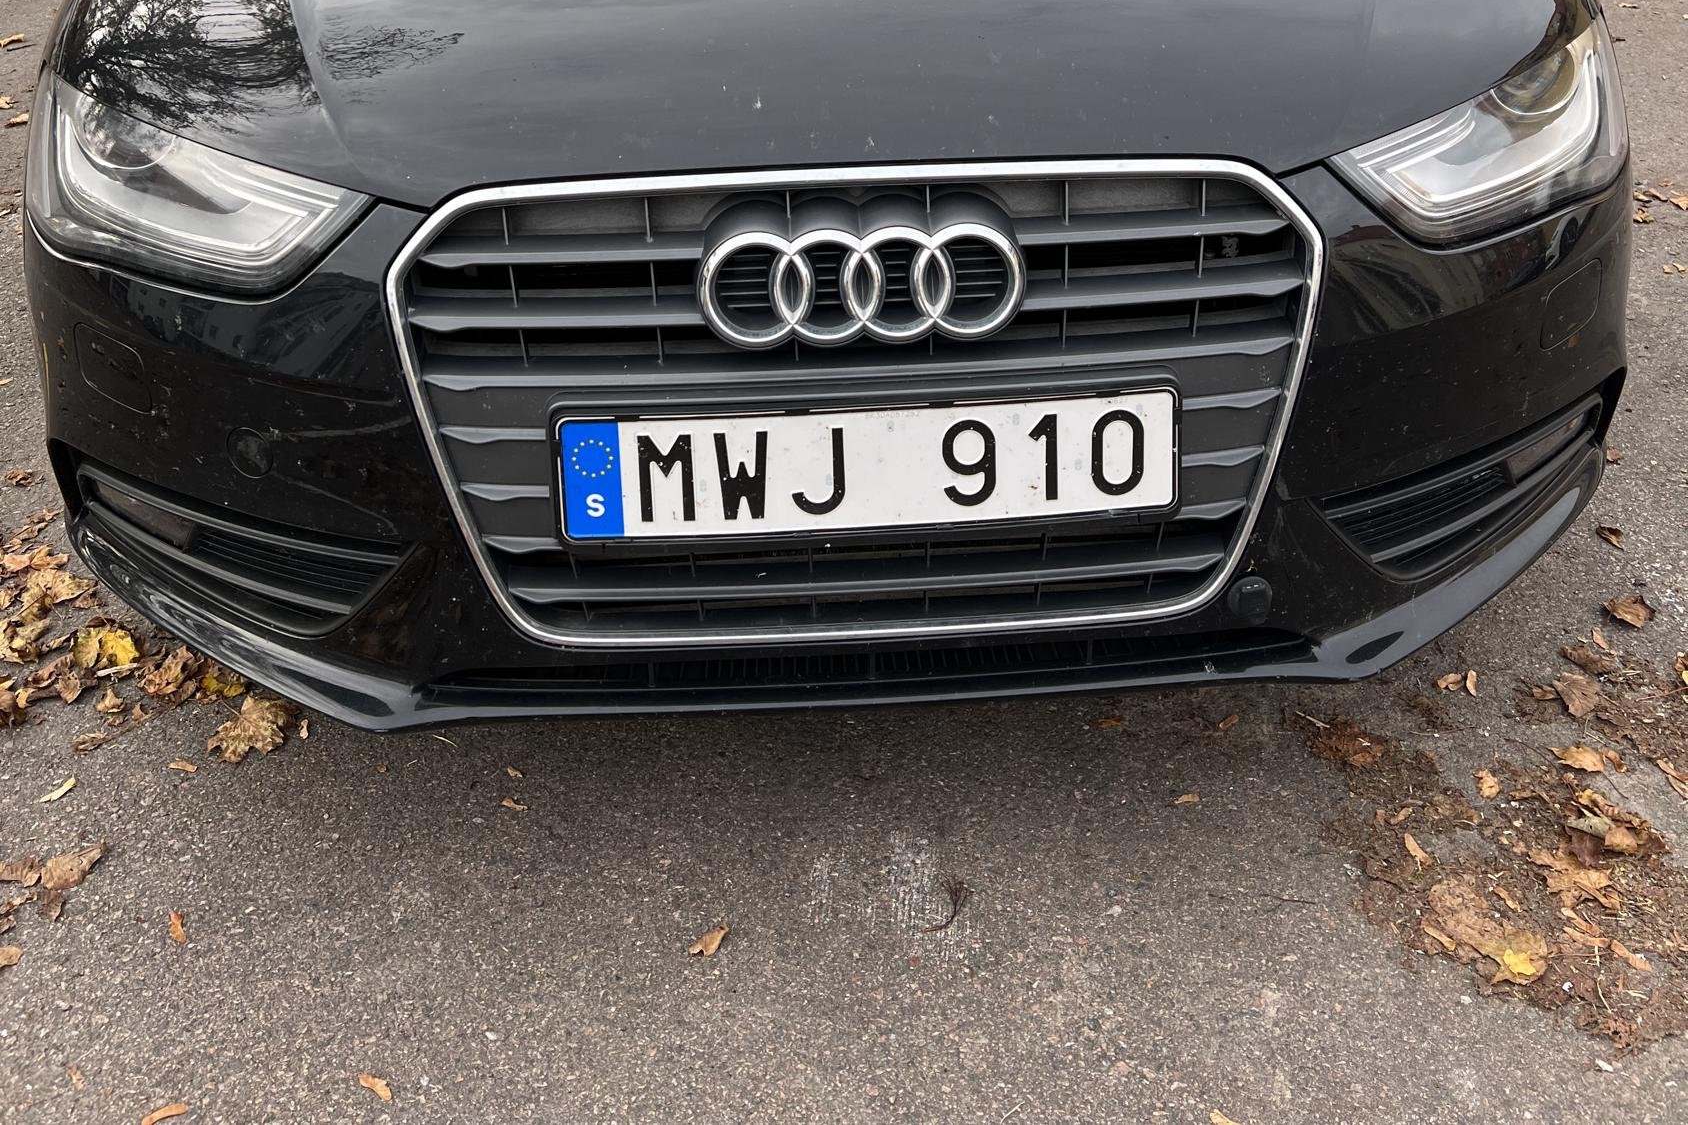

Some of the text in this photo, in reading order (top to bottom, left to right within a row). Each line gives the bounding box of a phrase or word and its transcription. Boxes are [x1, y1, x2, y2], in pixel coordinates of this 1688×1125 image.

[636, 409, 1145, 523] MWJ 910
[585, 493, 605, 518] S
